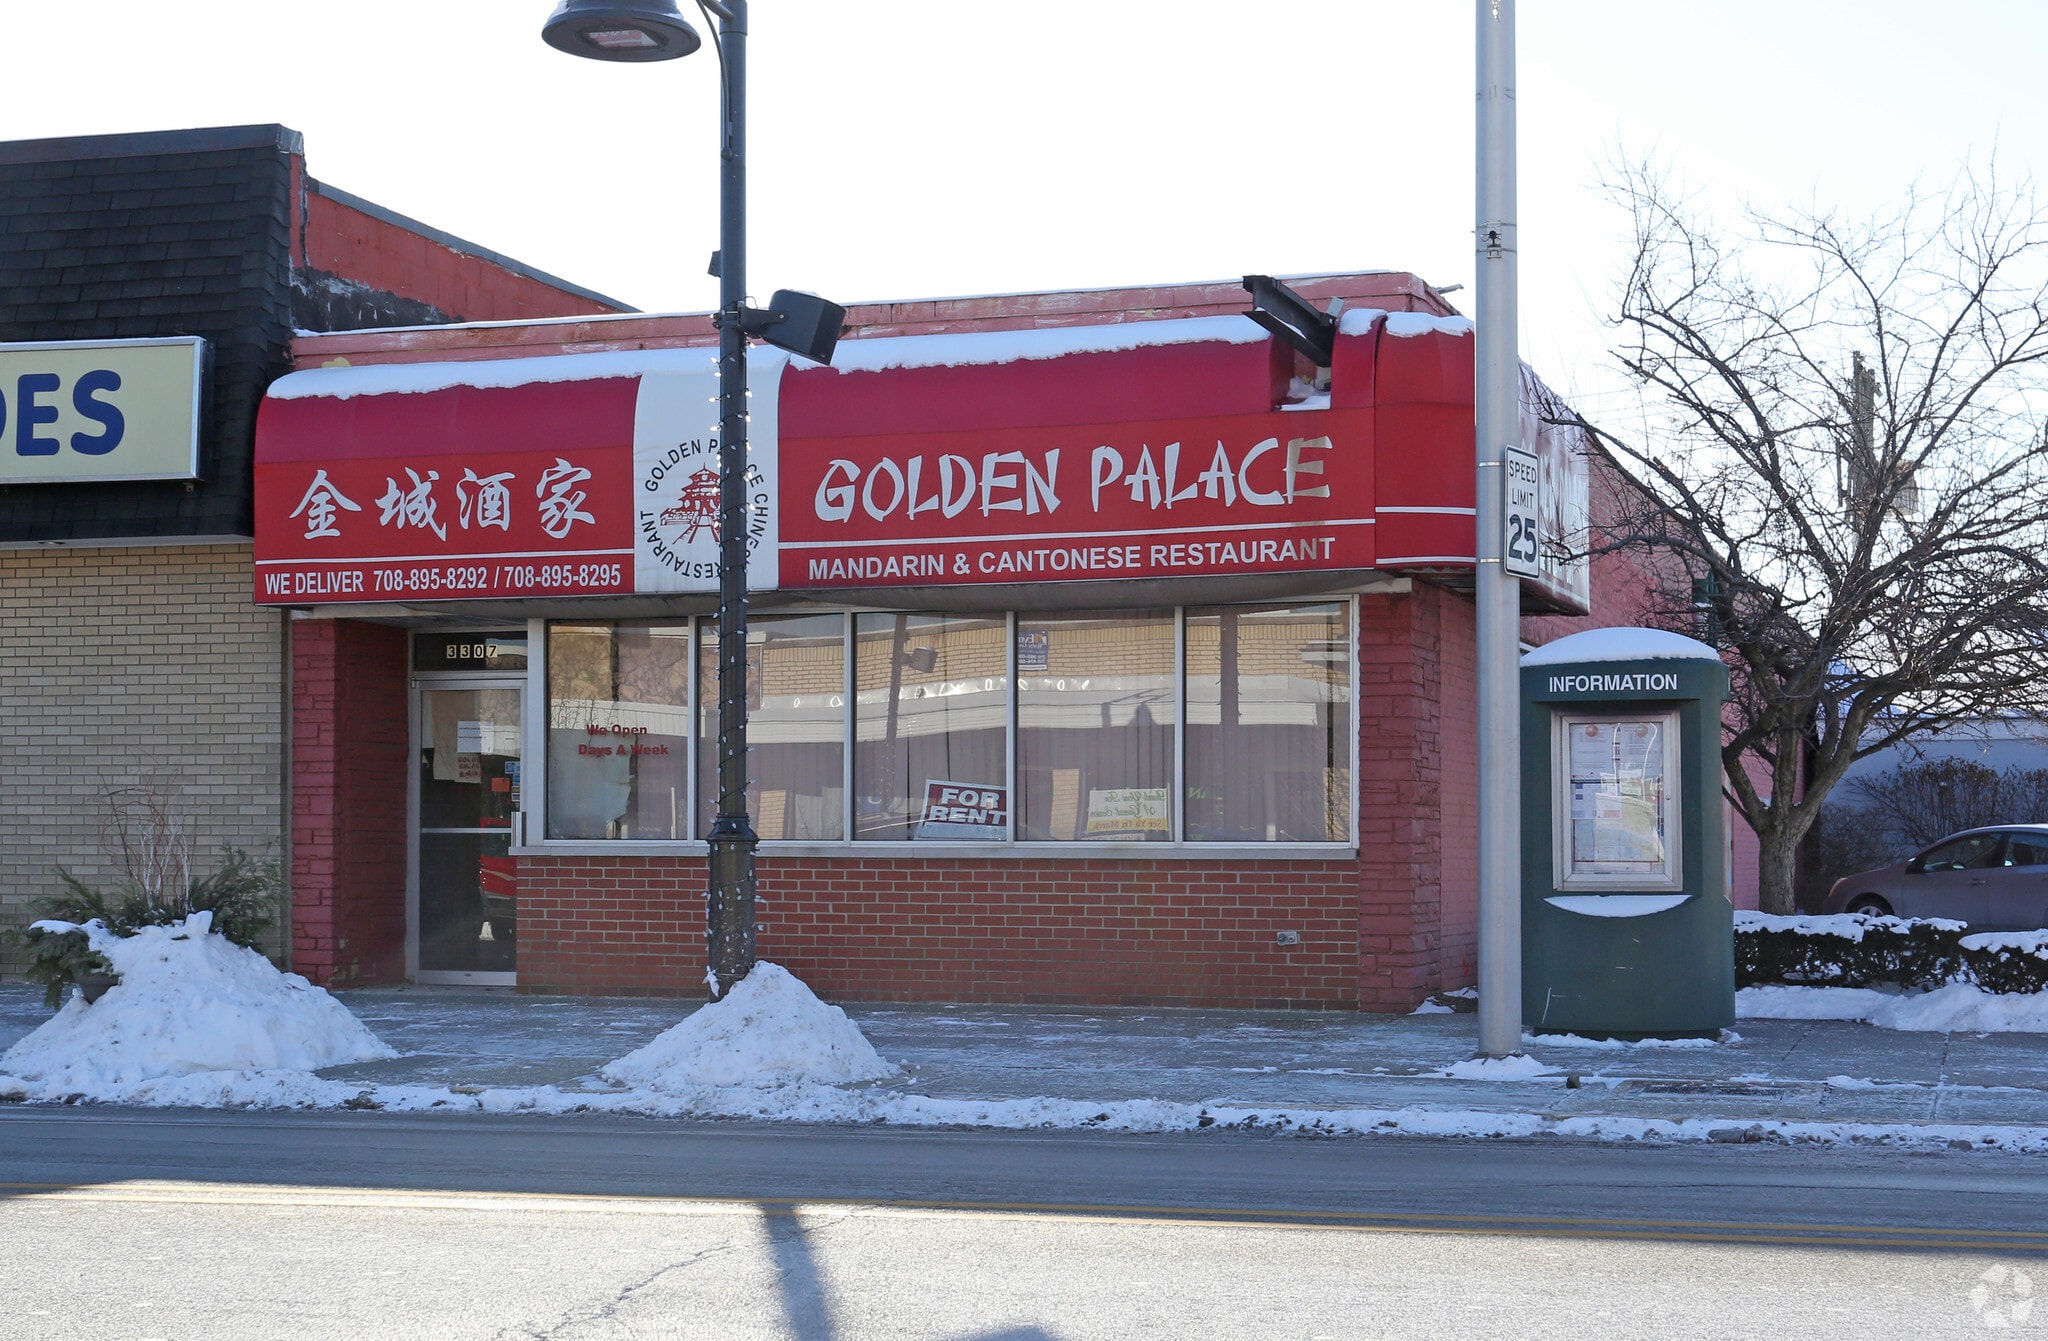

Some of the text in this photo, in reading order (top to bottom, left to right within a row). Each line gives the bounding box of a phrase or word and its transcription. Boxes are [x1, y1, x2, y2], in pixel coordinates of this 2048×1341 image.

[0, 369, 125, 456] ES
[645, 438, 702, 492] GOLDEN
[1509, 460, 1537, 484] SPEED
[815, 435, 1332, 523] GOLDEN PALACE
[289, 457, 595, 542] 金城酒家
[1511, 487, 1534, 510] LIMIT
[1508, 513, 1537, 563] 25
[808, 536, 1335, 581] MANDARIN & CANTONESE RESTAURANT
[265, 573, 290, 595] WE
[295, 571, 364, 594] DELIVER
[373, 567, 488, 592] 708-895-8292
[503, 564, 622, 589] 708-895-8295
[448, 645, 497, 658] 3307
[1549, 674, 1678, 693] INFORMATION
[586, 724, 648, 738] We Open
[578, 744, 669, 757] Days A Week
[941, 787, 1000, 809] FOR
[929, 805, 1007, 825] RENT
